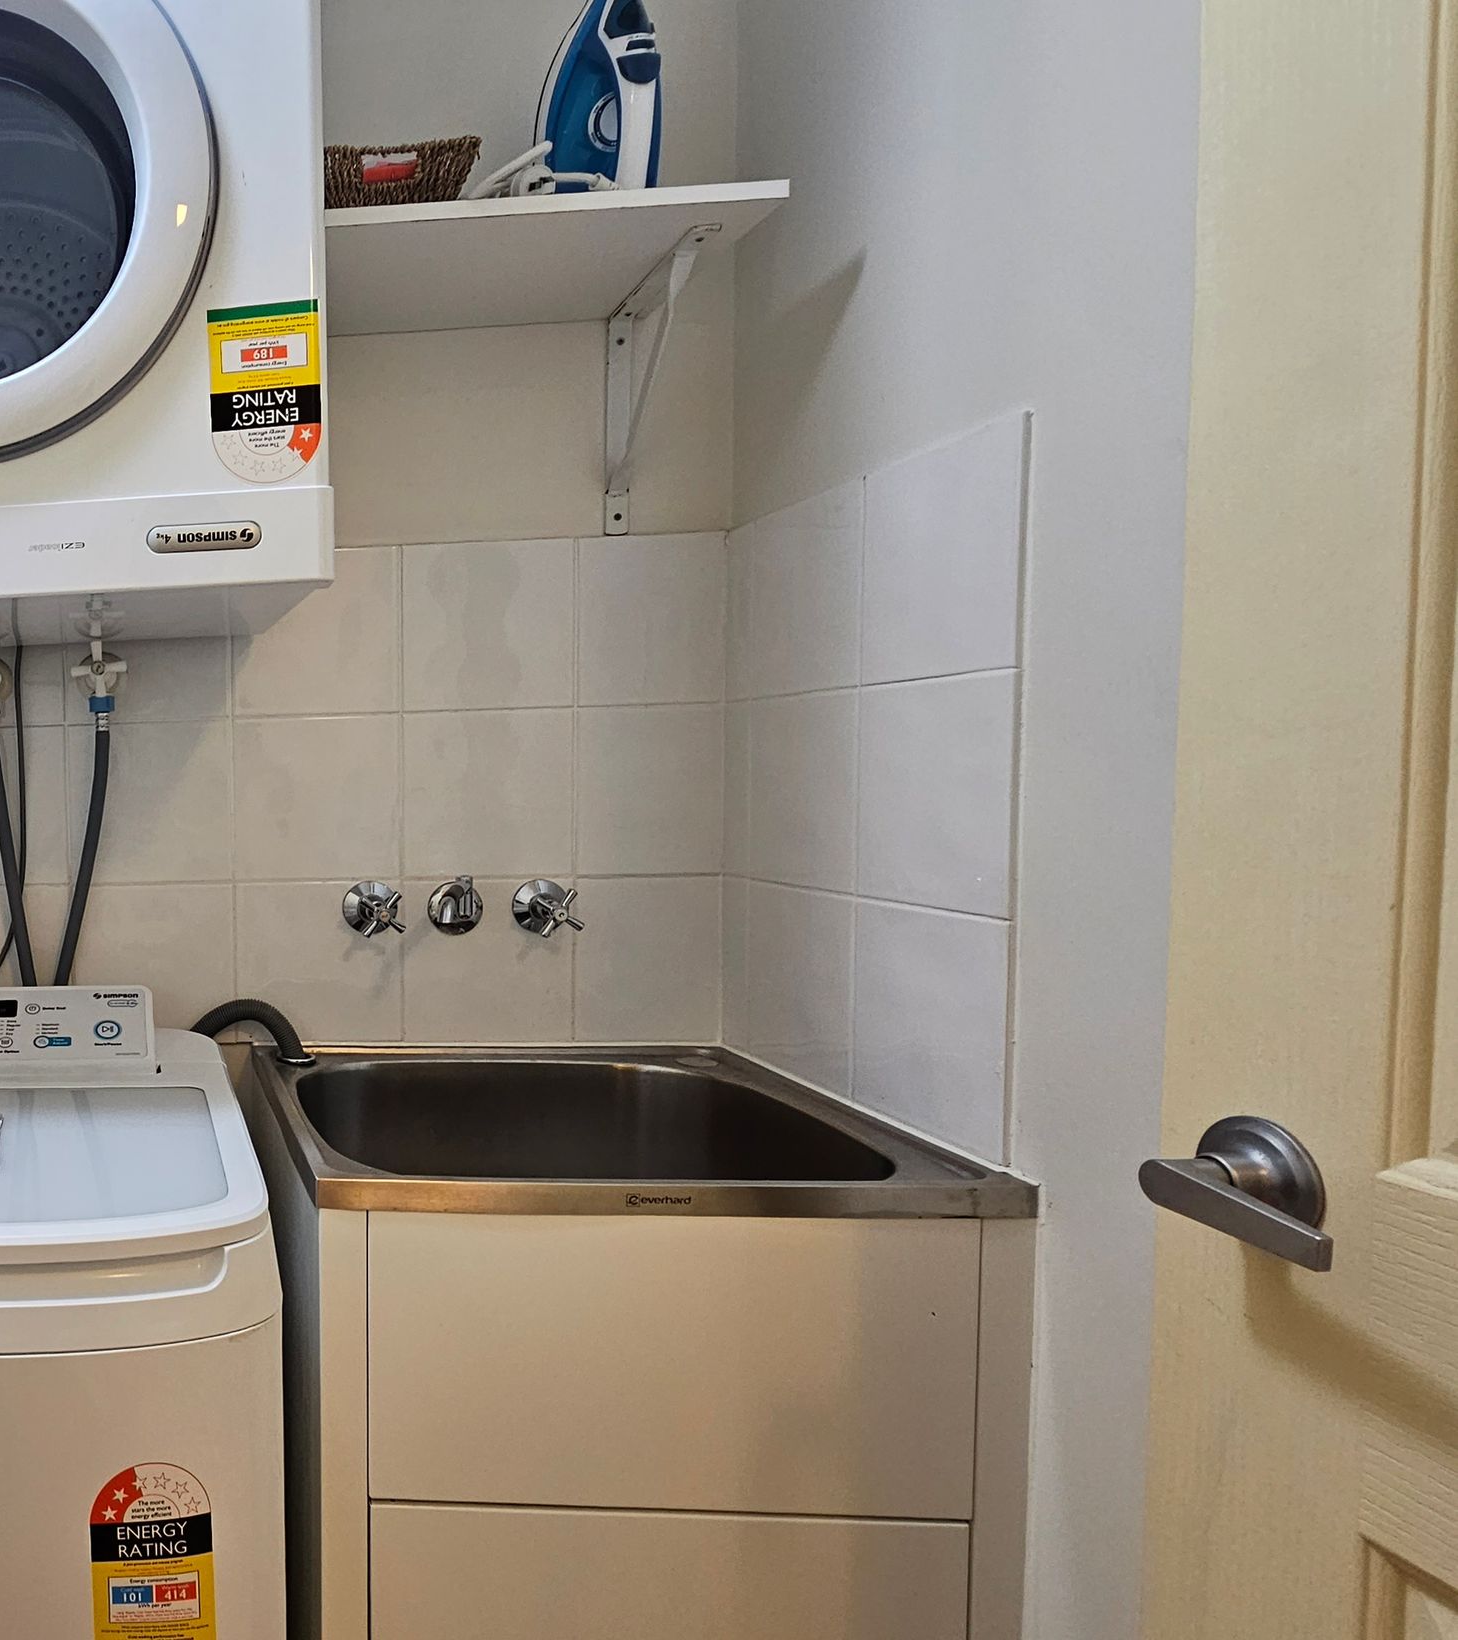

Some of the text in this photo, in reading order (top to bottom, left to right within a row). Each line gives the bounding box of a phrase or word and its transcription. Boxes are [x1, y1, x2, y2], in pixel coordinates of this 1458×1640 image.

[253, 348, 273, 360] 189
[232, 388, 296, 409] RATING
[231, 406, 300, 427] ENERGY
[269, 428, 286, 436] energy
[177, 530, 238, 544] SIMPSON
[641, 1195, 692, 1205] everhard
[156, 1504, 172, 1512] more
[130, 1511, 172, 1520] energy efficient
[116, 1520, 188, 1541] ENERGY
[118, 1540, 188, 1559] RATING
[147, 1576, 179, 1584] consumption
[123, 1592, 143, 1603] 101
[164, 1588, 187, 1601] 414
